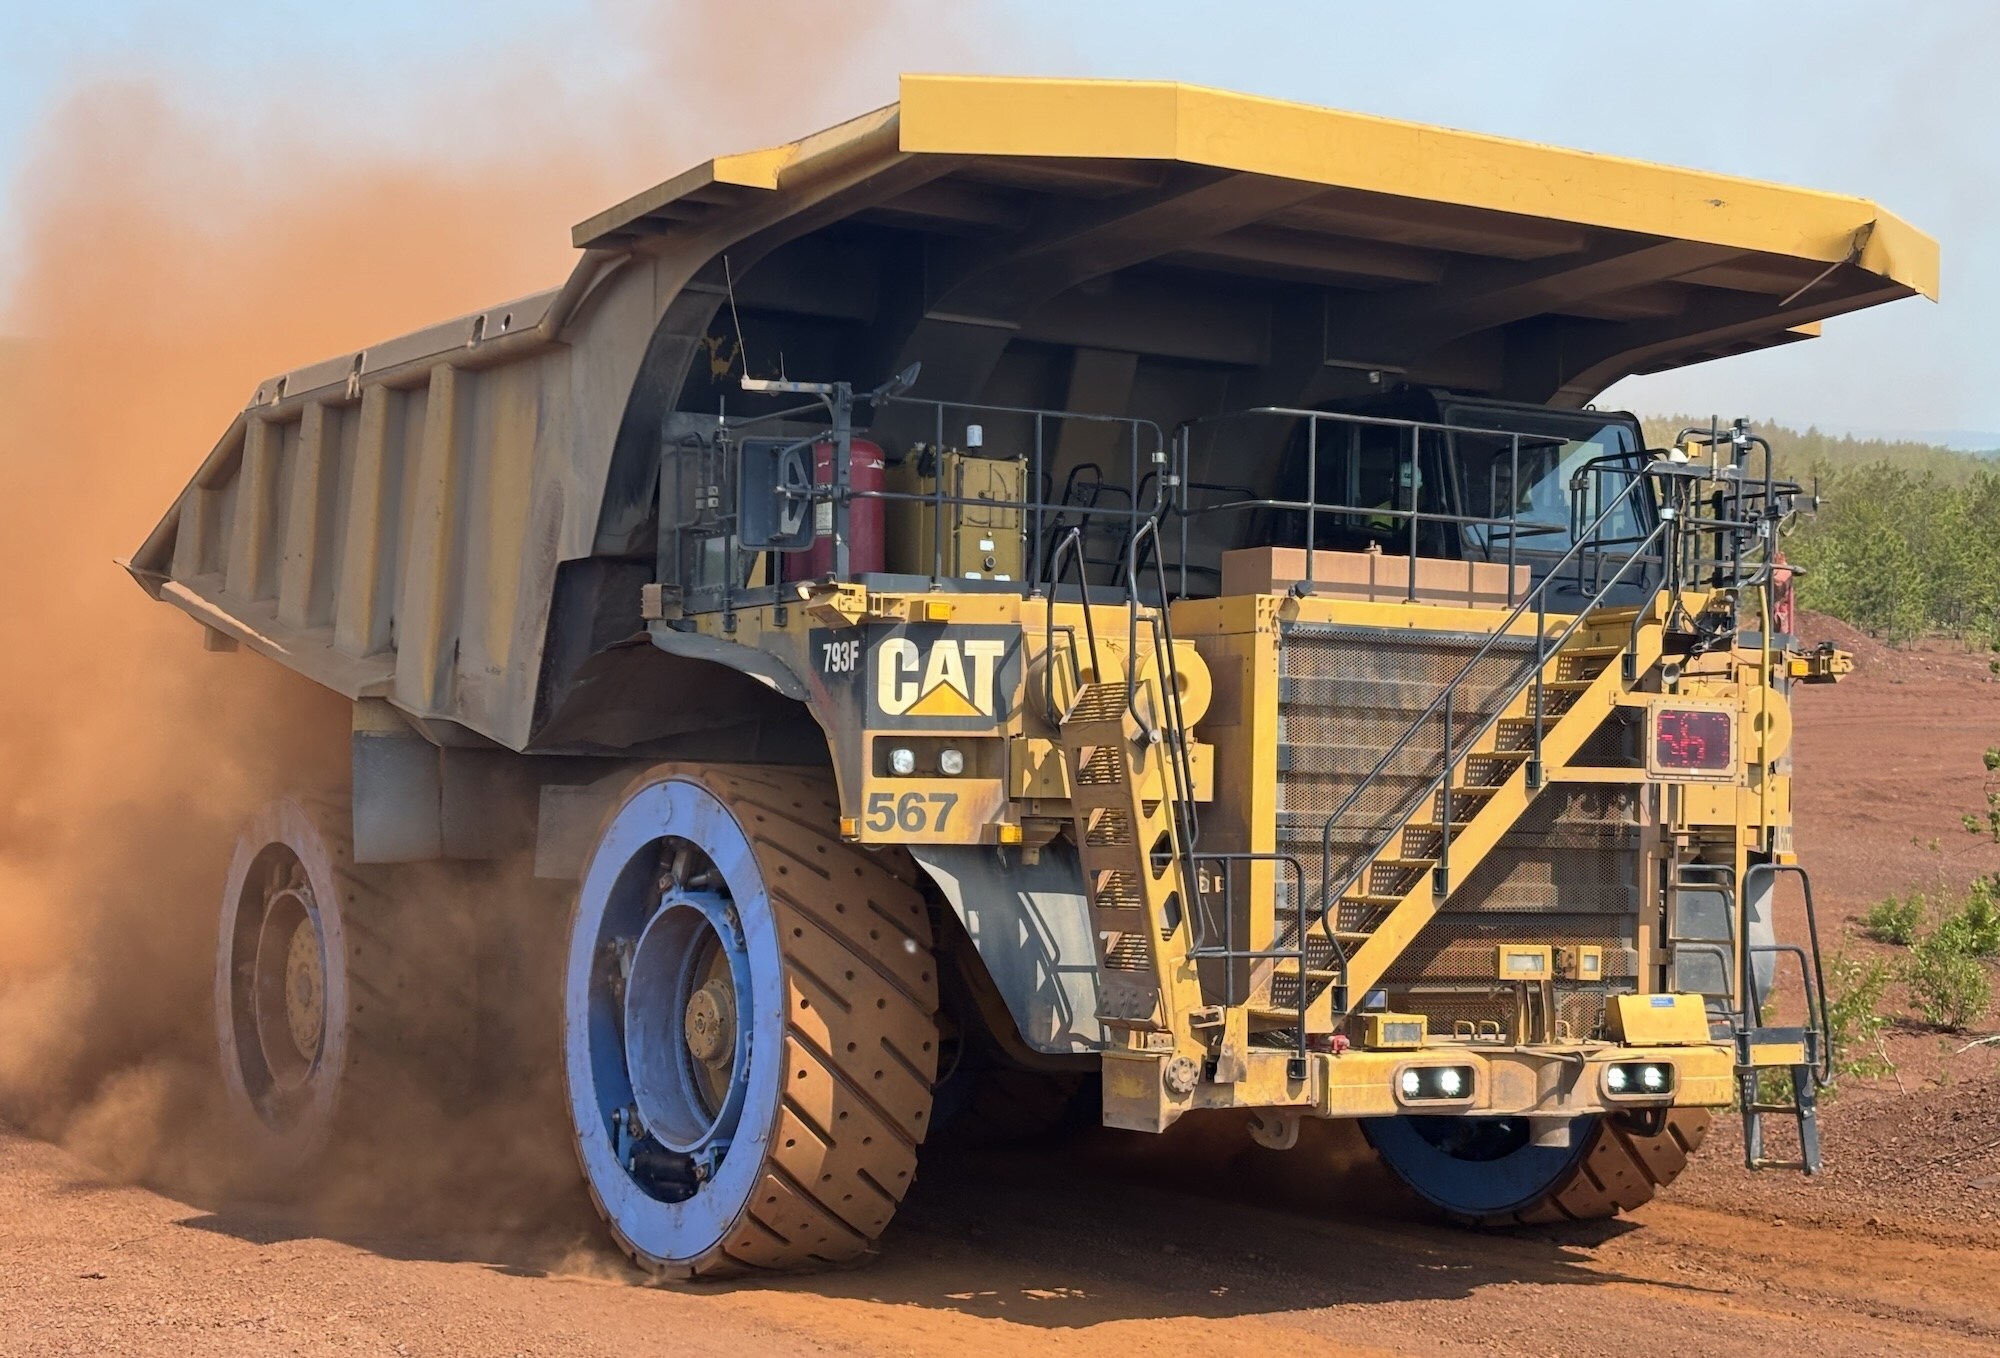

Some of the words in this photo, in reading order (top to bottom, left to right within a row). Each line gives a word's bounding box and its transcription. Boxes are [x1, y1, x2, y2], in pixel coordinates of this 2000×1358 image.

[823, 640, 859, 673] 793F
[878, 637, 1005, 717] CAT
[866, 791, 959, 833] 567
